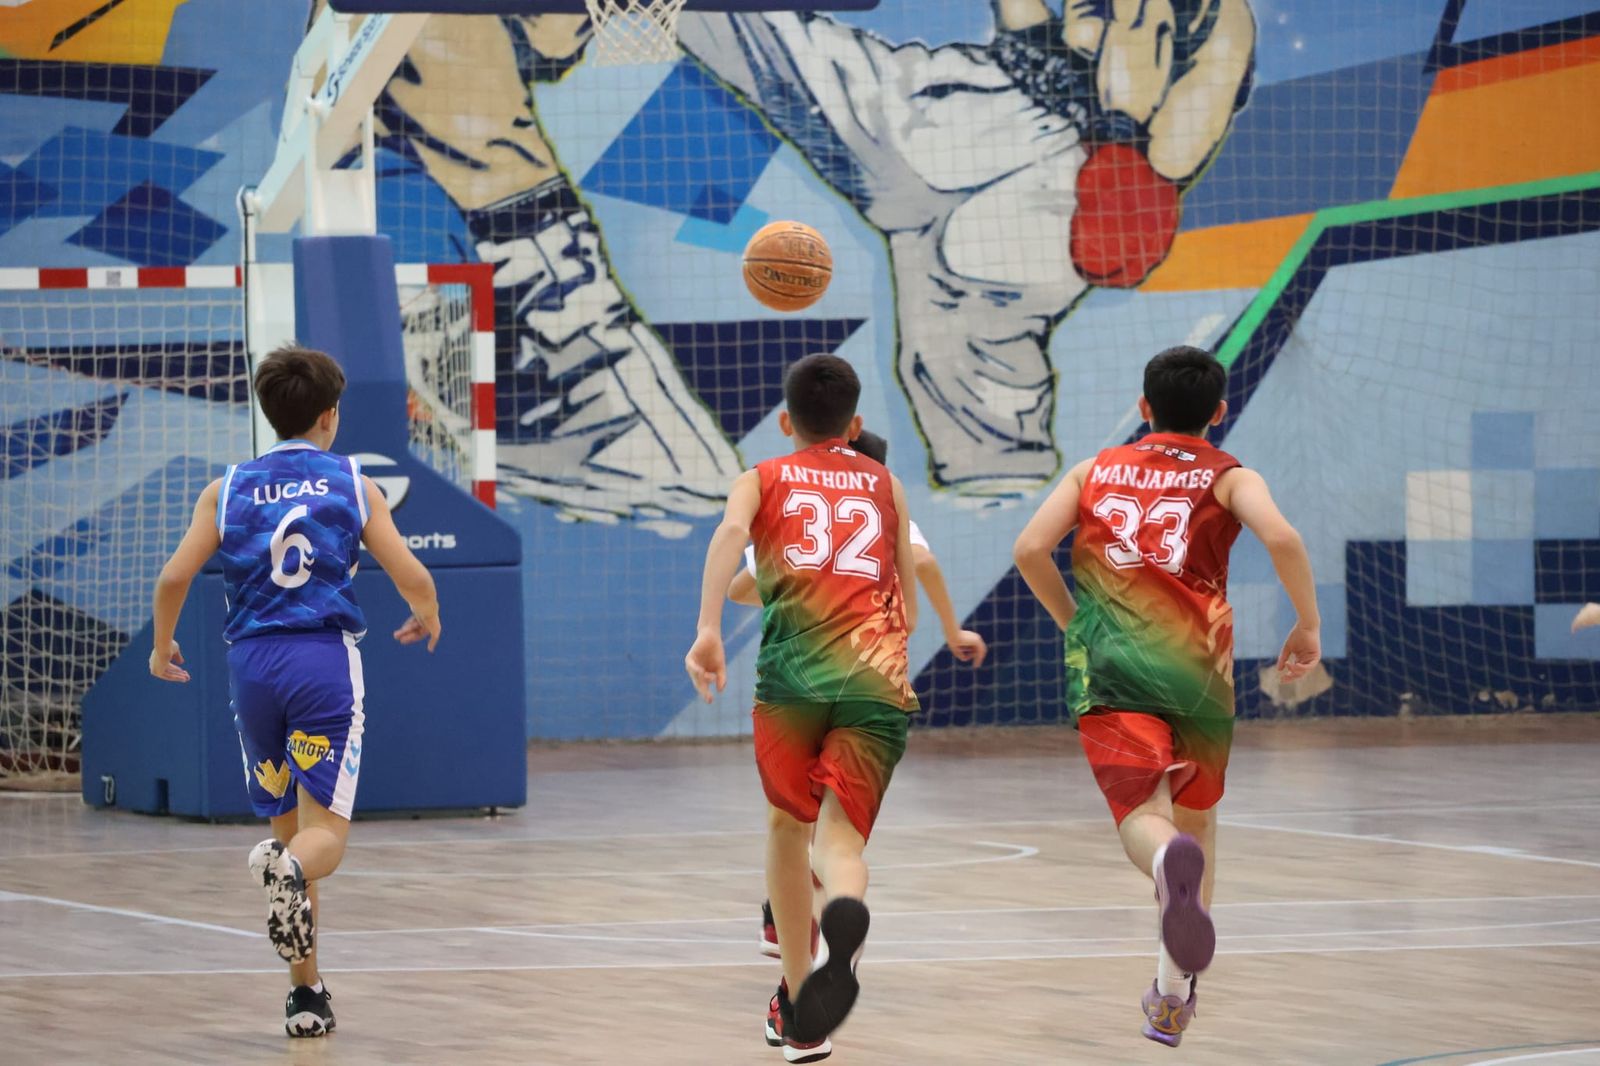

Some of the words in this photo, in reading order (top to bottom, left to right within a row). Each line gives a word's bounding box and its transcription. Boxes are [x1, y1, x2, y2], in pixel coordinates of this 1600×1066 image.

[253, 479, 329, 505] LUCAS
[780, 464, 878, 492] ANTHONY
[1091, 464, 1214, 489] MANJARRES
[270, 504, 315, 588] 6
[783, 489, 882, 581] 32
[1093, 493, 1194, 577] 33
